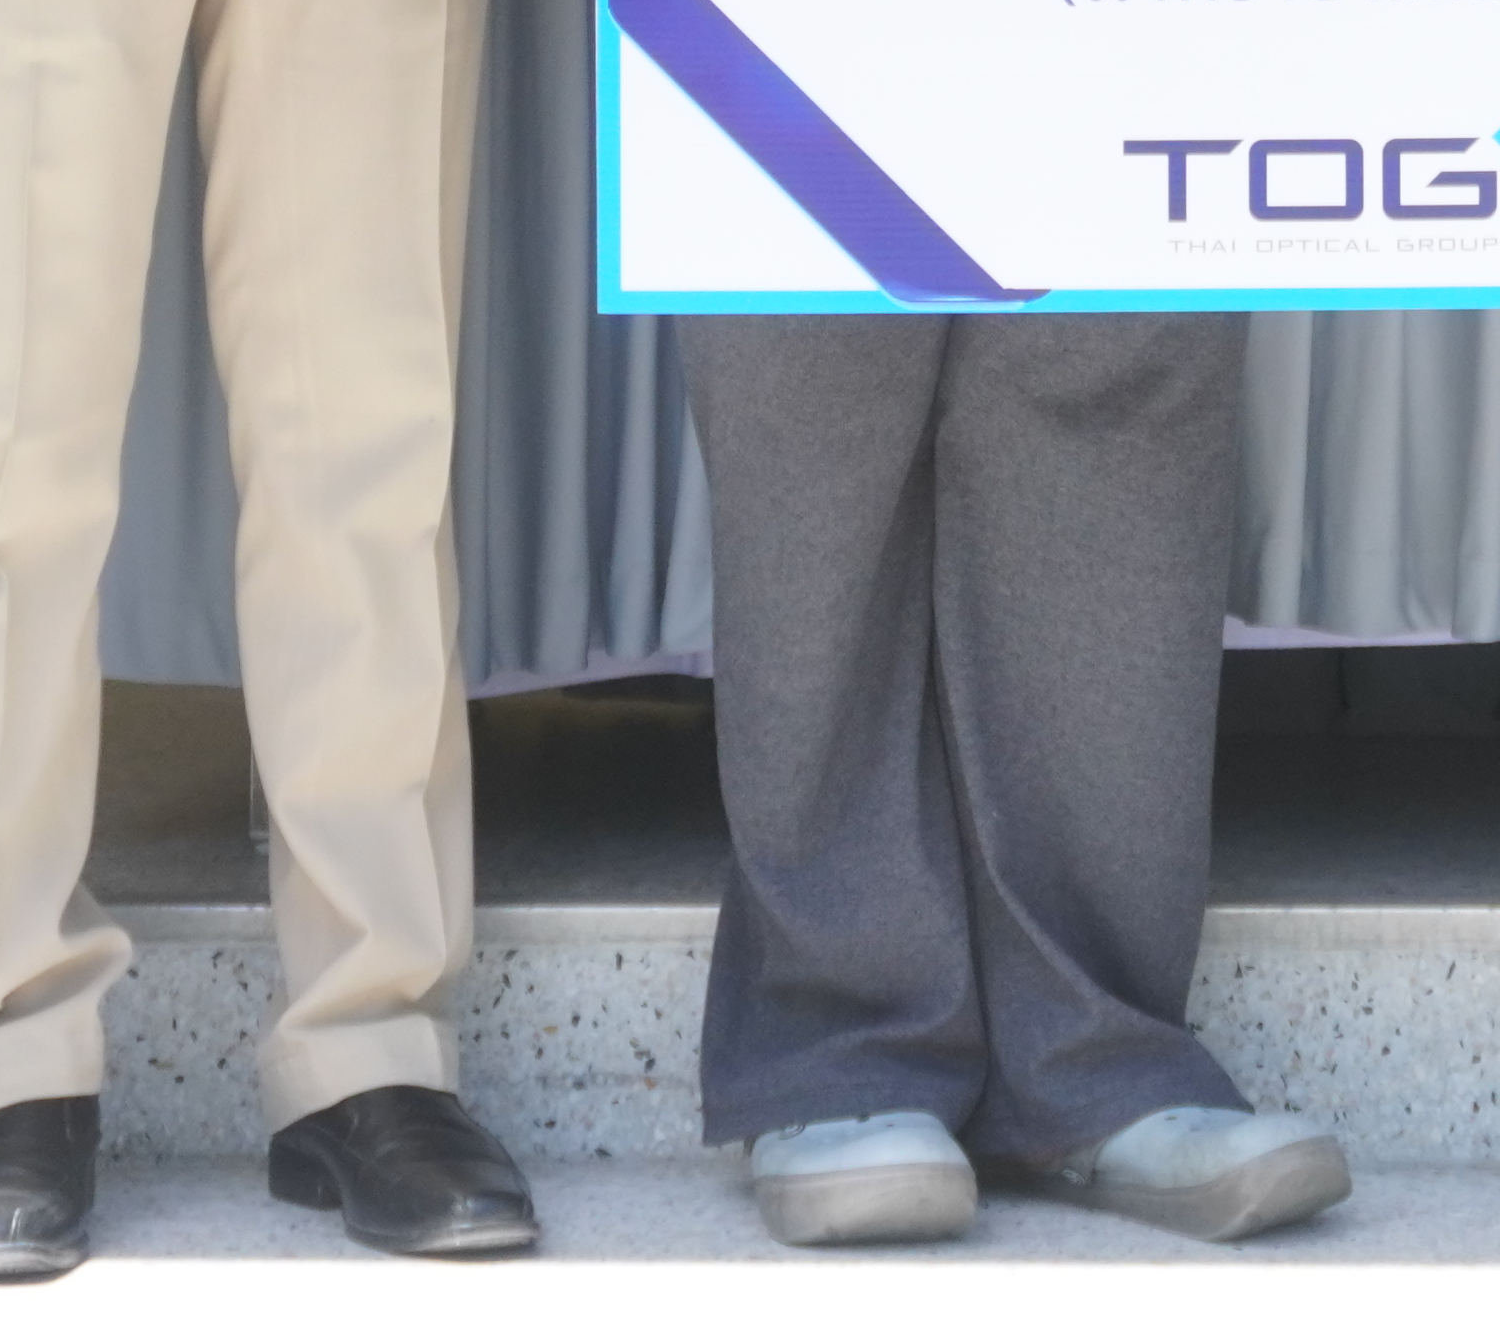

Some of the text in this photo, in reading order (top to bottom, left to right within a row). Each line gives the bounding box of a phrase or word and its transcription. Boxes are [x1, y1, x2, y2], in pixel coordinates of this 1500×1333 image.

[1122, 137, 1498, 223] TOG
[1168, 237, 1498, 253] THAI OPTICAL GROUP
